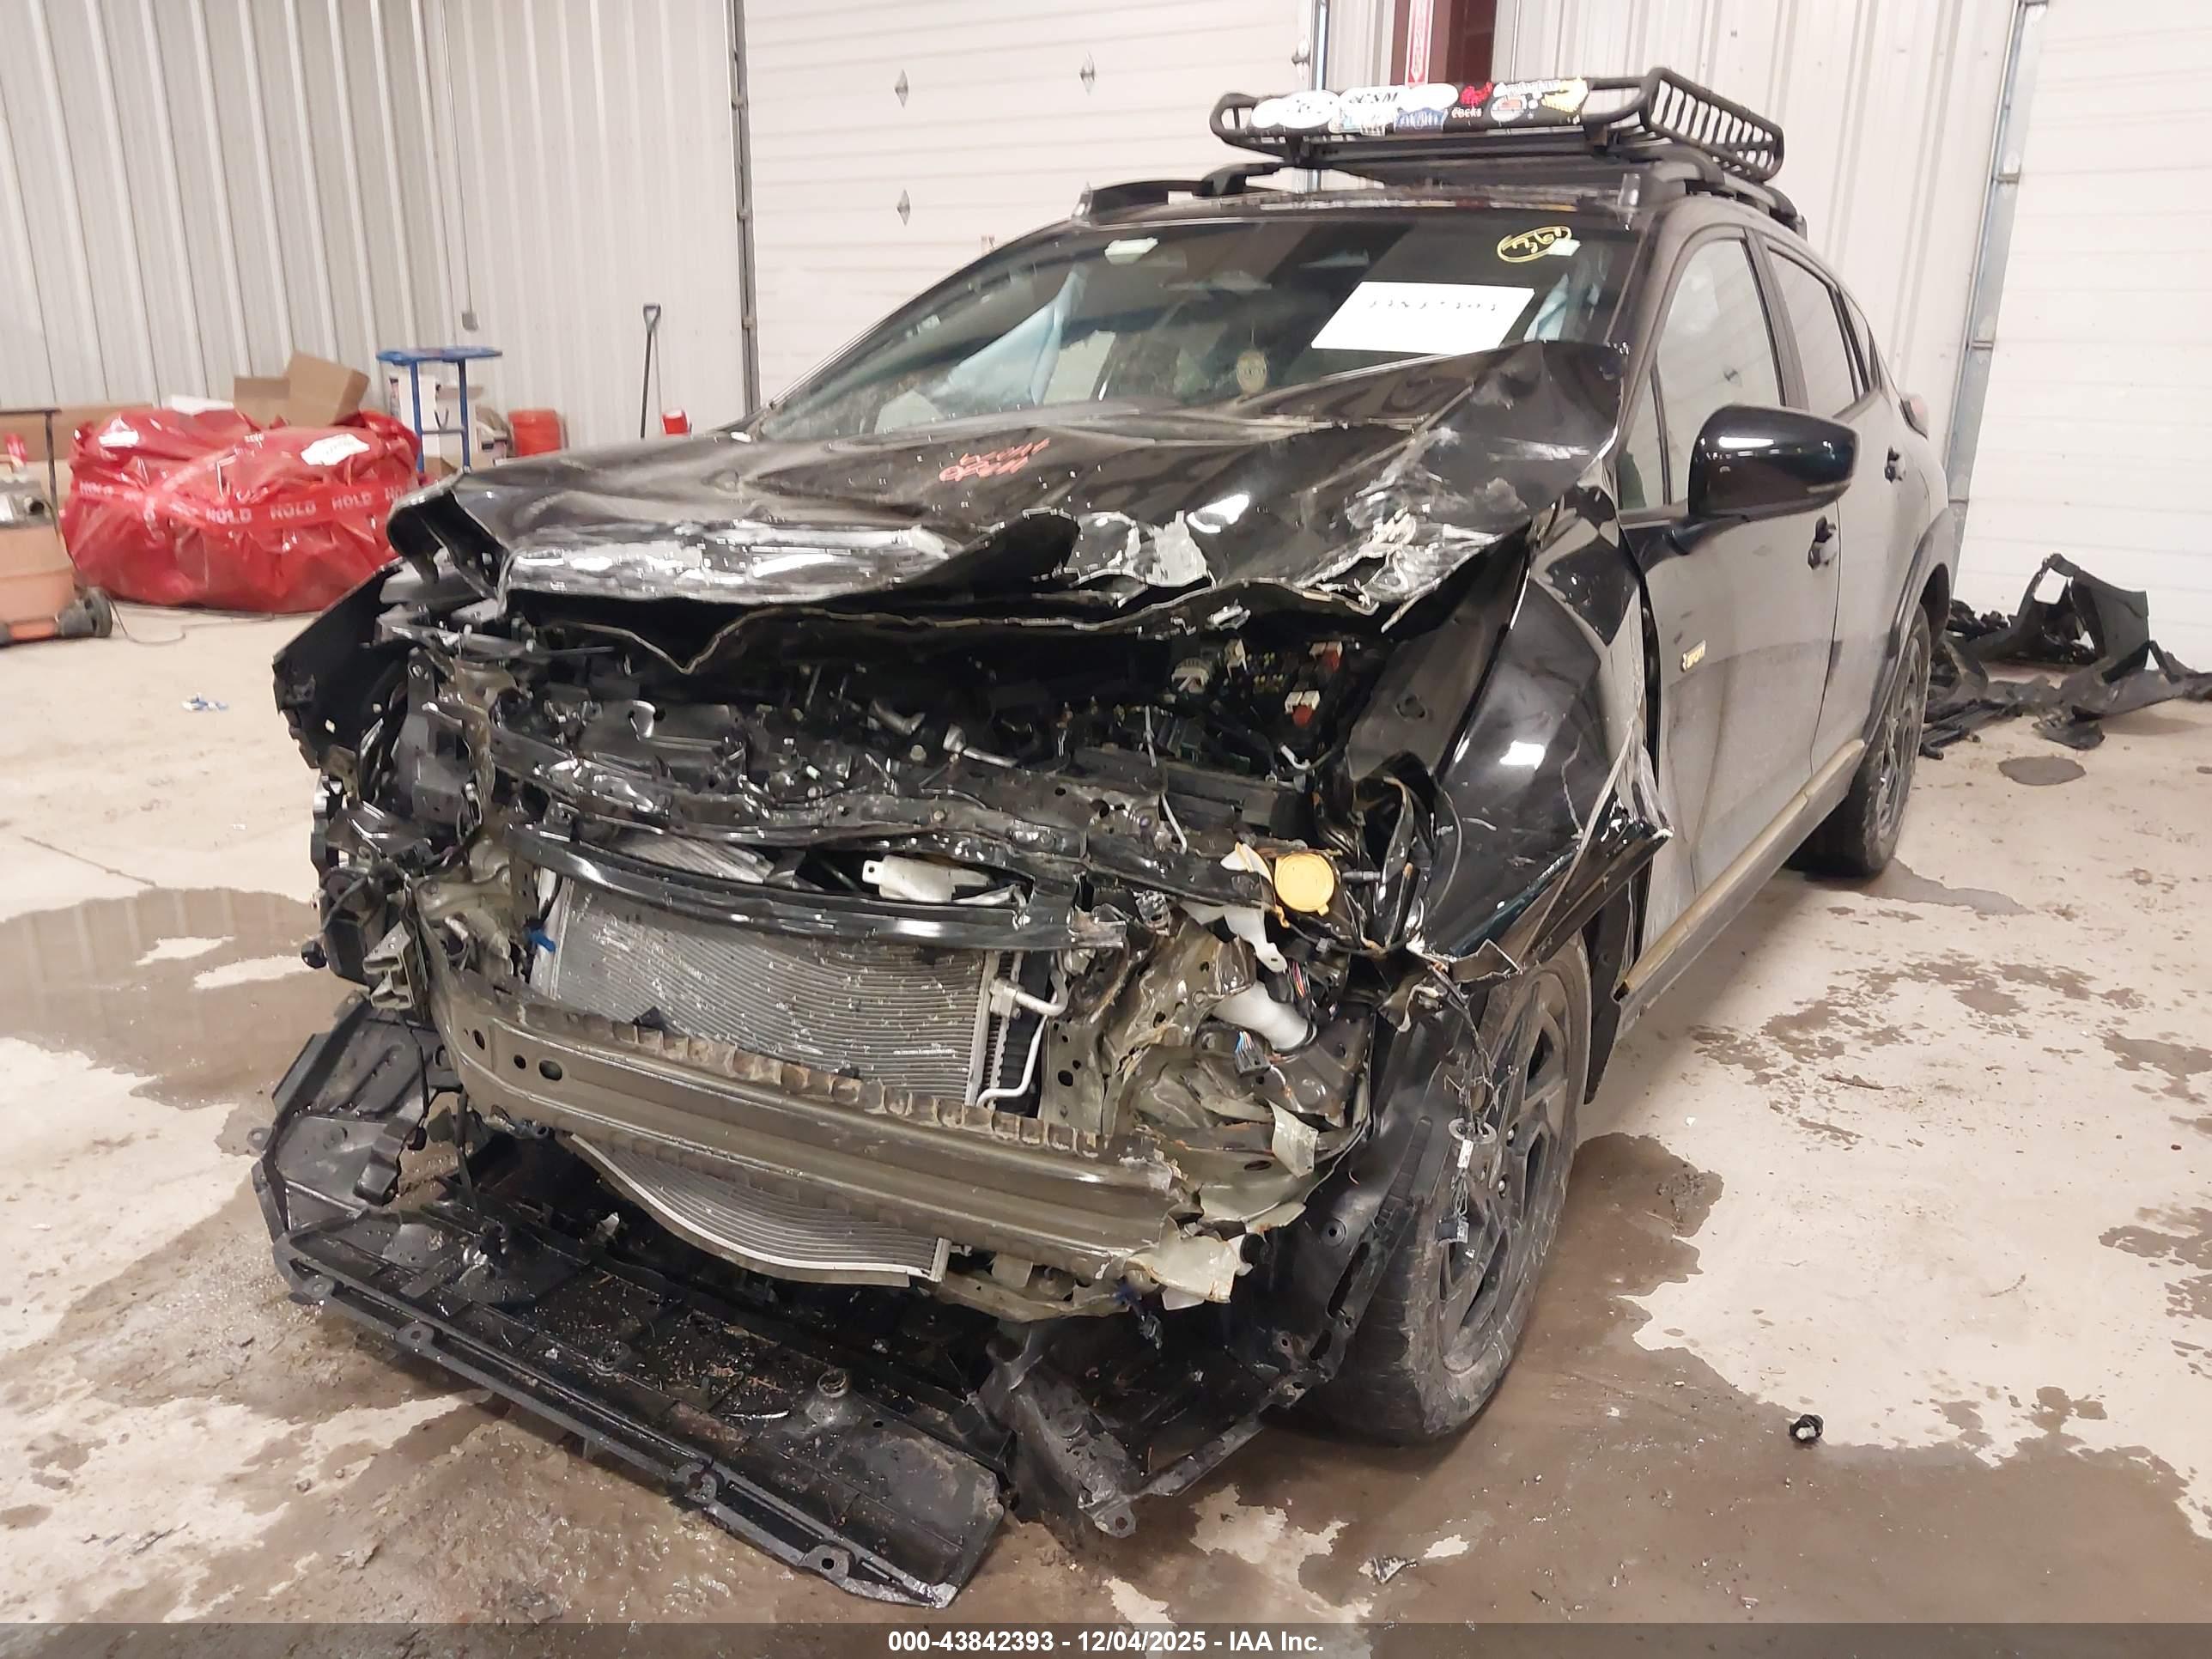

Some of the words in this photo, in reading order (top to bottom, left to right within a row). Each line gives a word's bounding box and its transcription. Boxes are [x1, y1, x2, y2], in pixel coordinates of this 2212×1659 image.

[205, 507, 252, 525] HOLD
[269, 501, 317, 520] HOLD
[331, 491, 372, 511] HOLD
